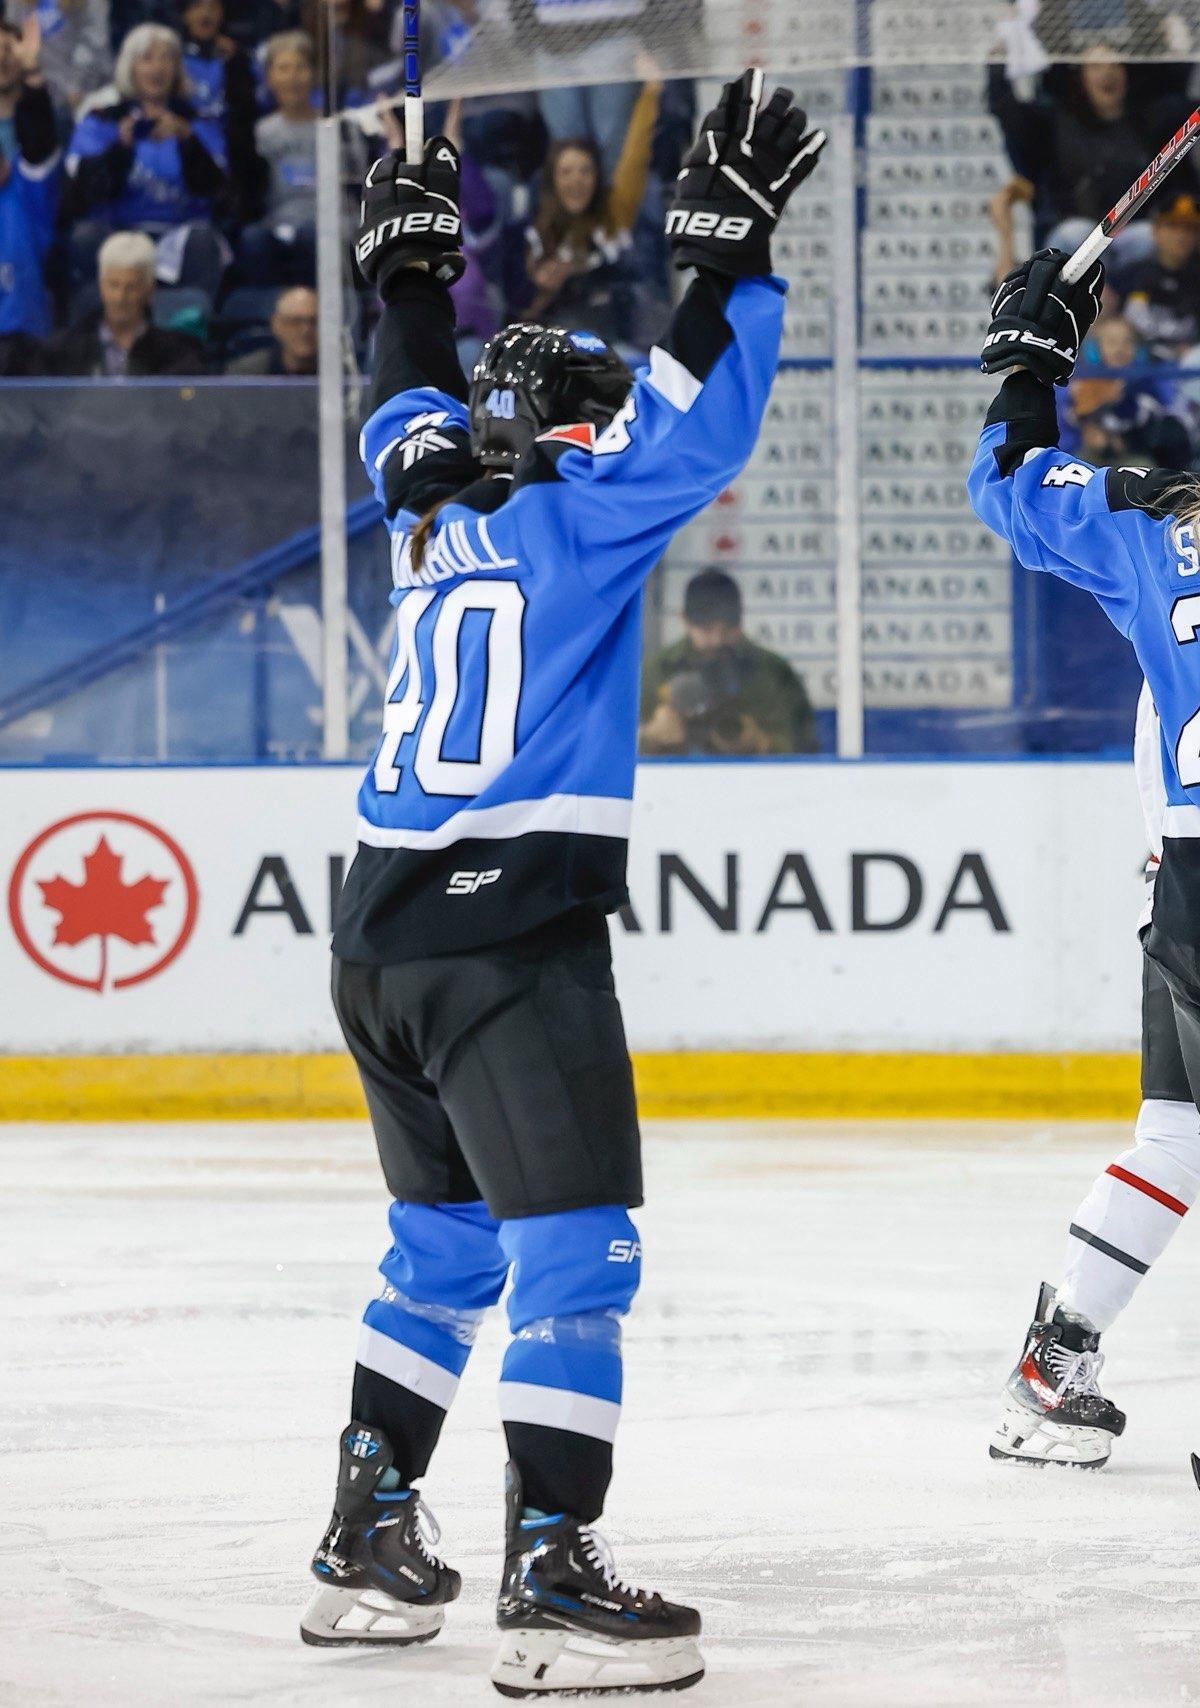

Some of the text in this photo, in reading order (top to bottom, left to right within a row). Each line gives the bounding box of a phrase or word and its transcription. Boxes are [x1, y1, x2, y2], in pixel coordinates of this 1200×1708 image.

[355, 212, 460, 265] BAUE
[486, 388, 515, 420] 40
[374, 580, 527, 797] 40
[232, 854, 1011, 934] AI NADA
[445, 868, 502, 895] SP
